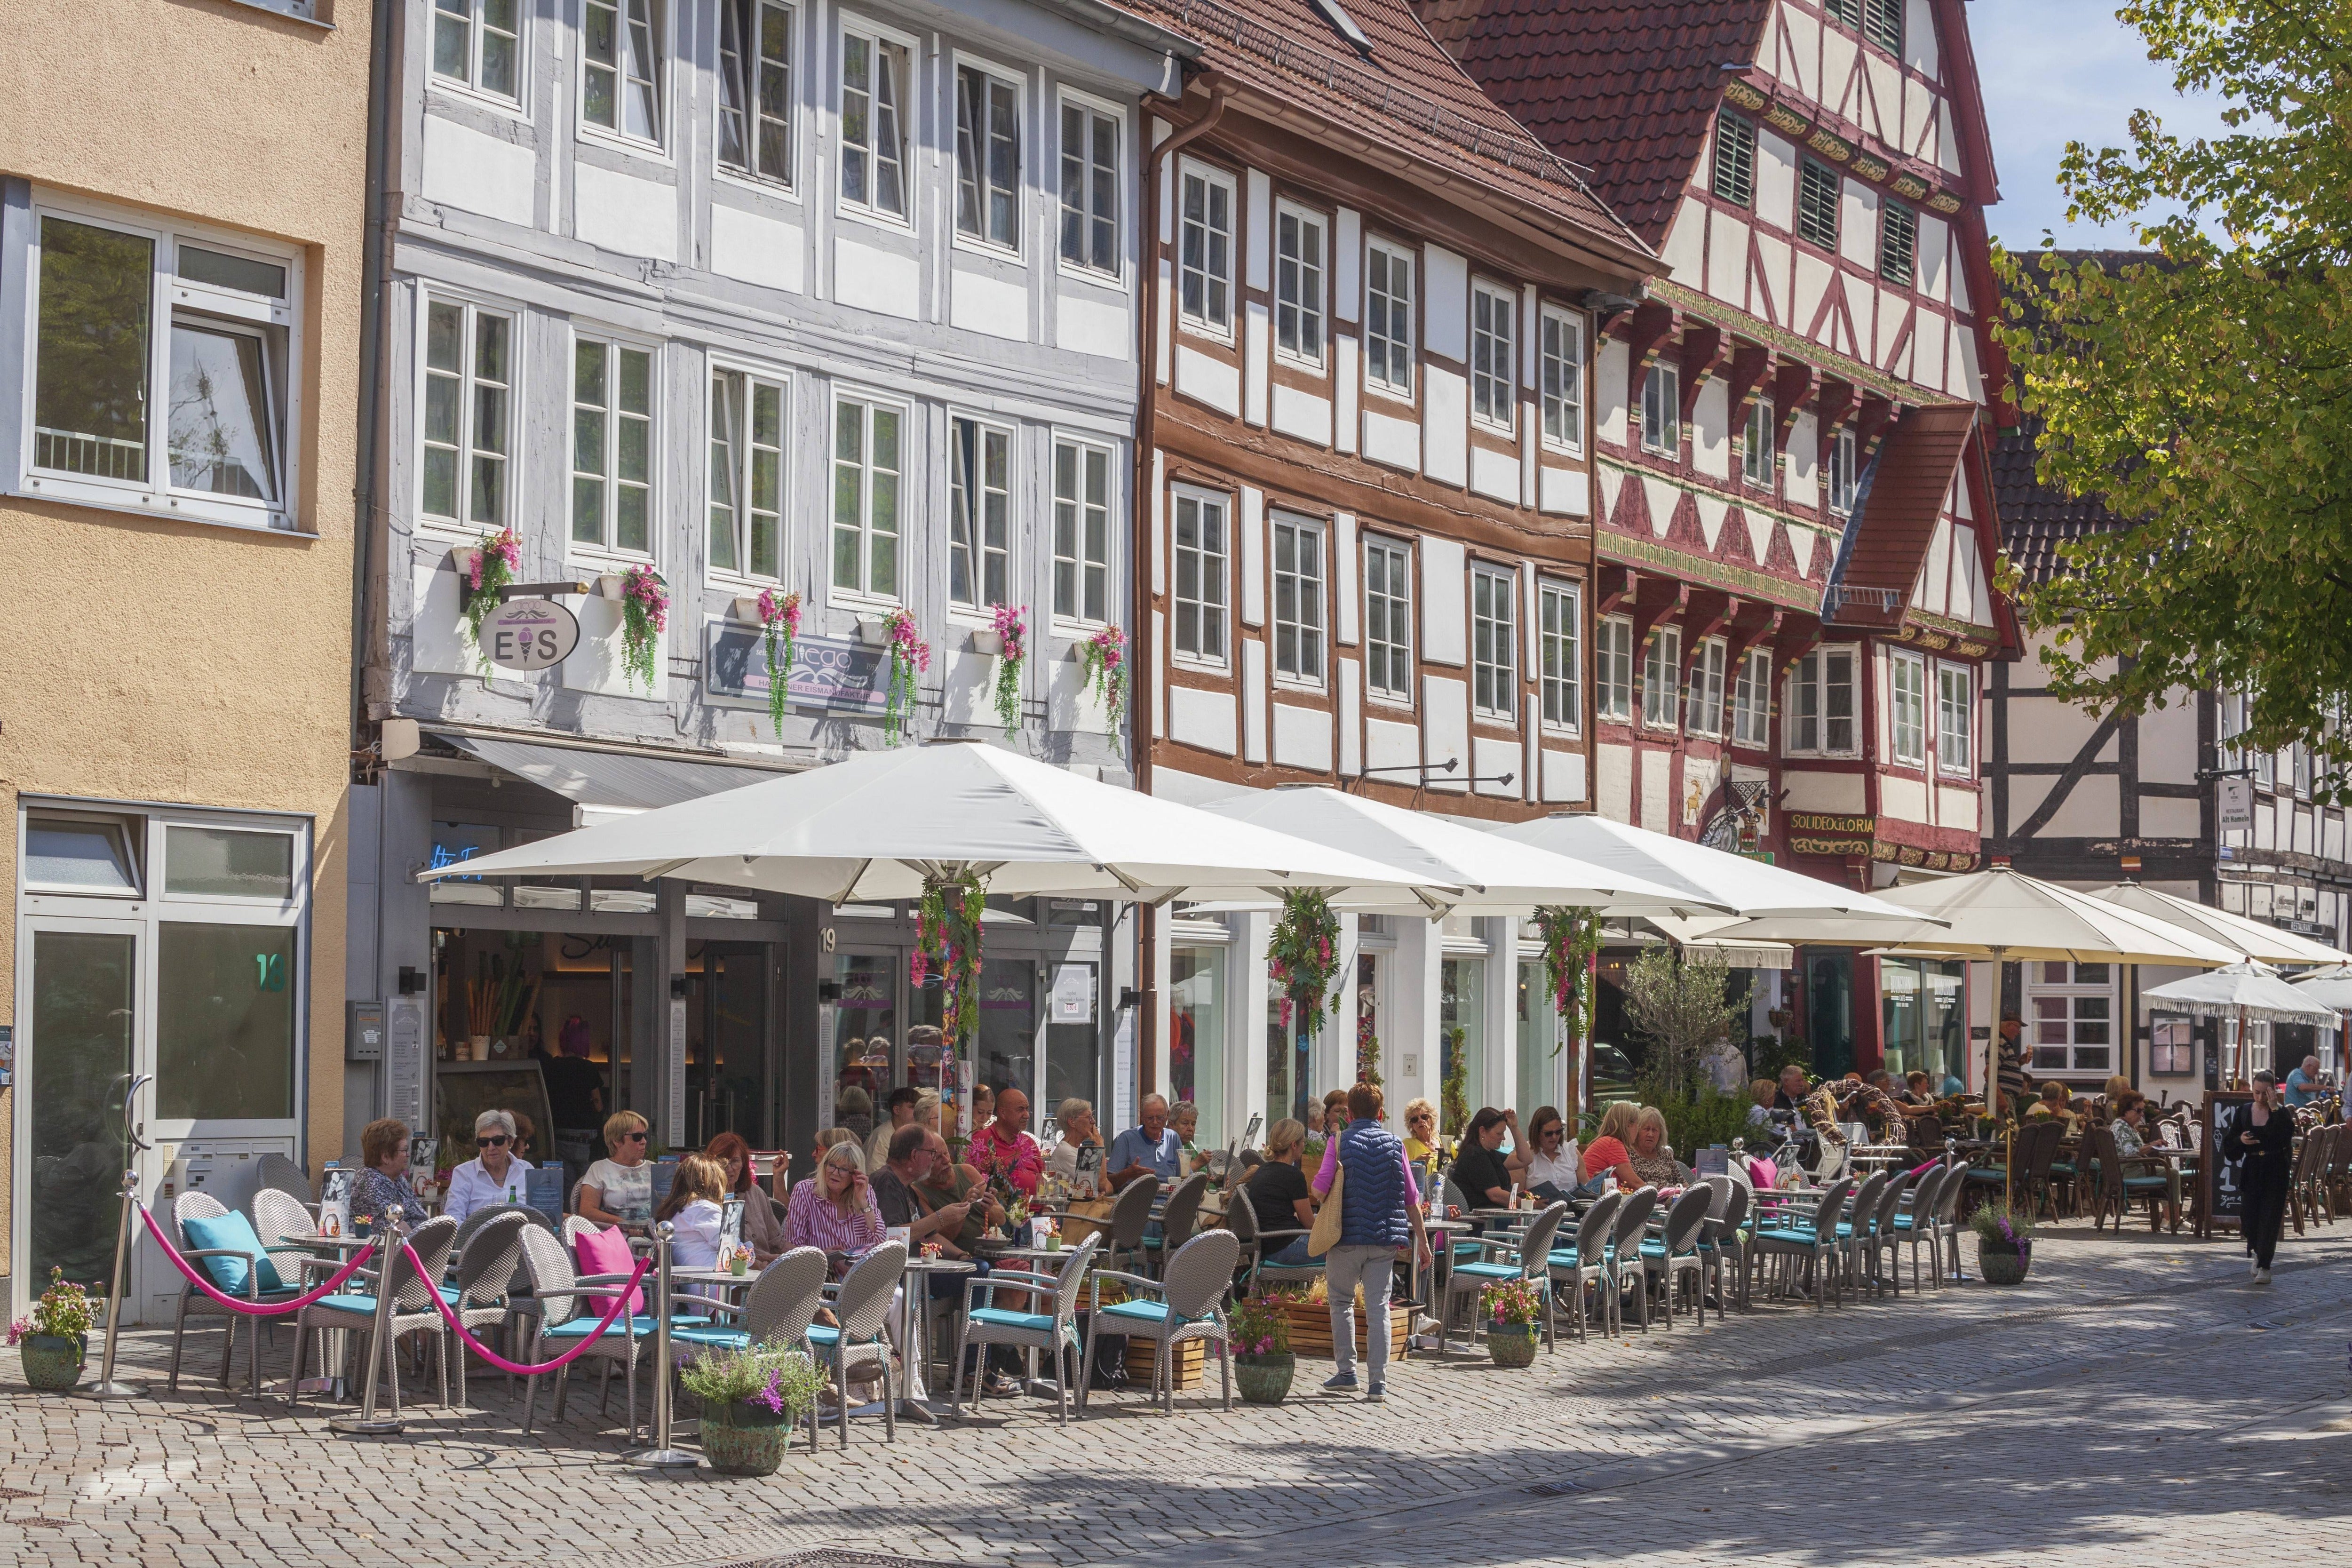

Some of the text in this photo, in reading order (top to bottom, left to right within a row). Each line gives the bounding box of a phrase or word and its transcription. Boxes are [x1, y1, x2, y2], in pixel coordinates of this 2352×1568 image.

[758, 679, 871, 700] HANER EISMANUFAKTUR
[820, 928, 835, 953] 19
[256, 954, 285, 993] 18
